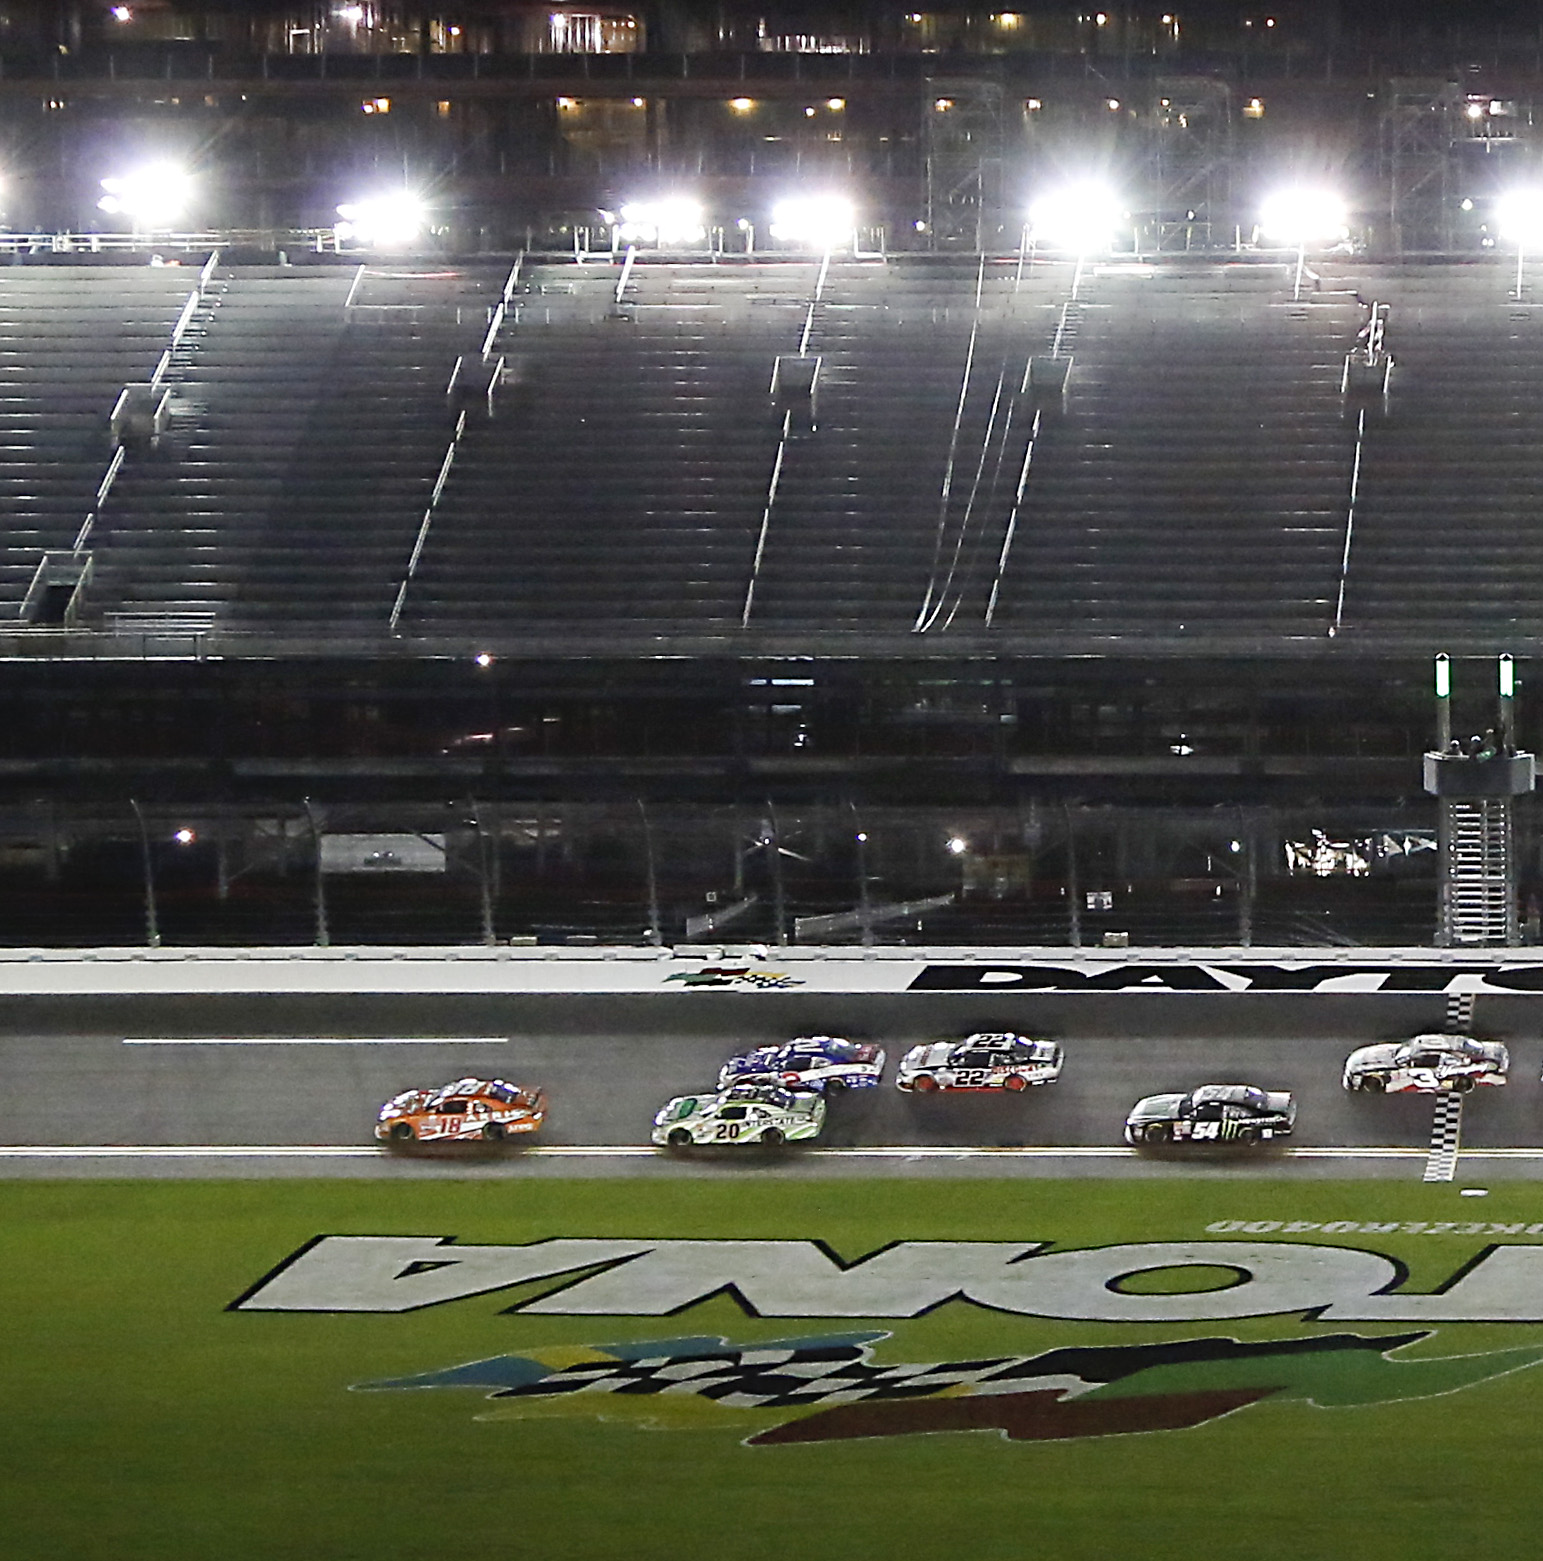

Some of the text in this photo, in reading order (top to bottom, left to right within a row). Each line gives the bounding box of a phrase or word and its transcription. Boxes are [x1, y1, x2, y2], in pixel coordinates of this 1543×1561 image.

[972, 1034, 1006, 1048] 22
[954, 1070, 985, 1086] 22
[1408, 1067, 1440, 1088] 3
[441, 1116, 461, 1134] 18
[716, 1123, 740, 1139] 20
[1191, 1121, 1221, 1140] 54
